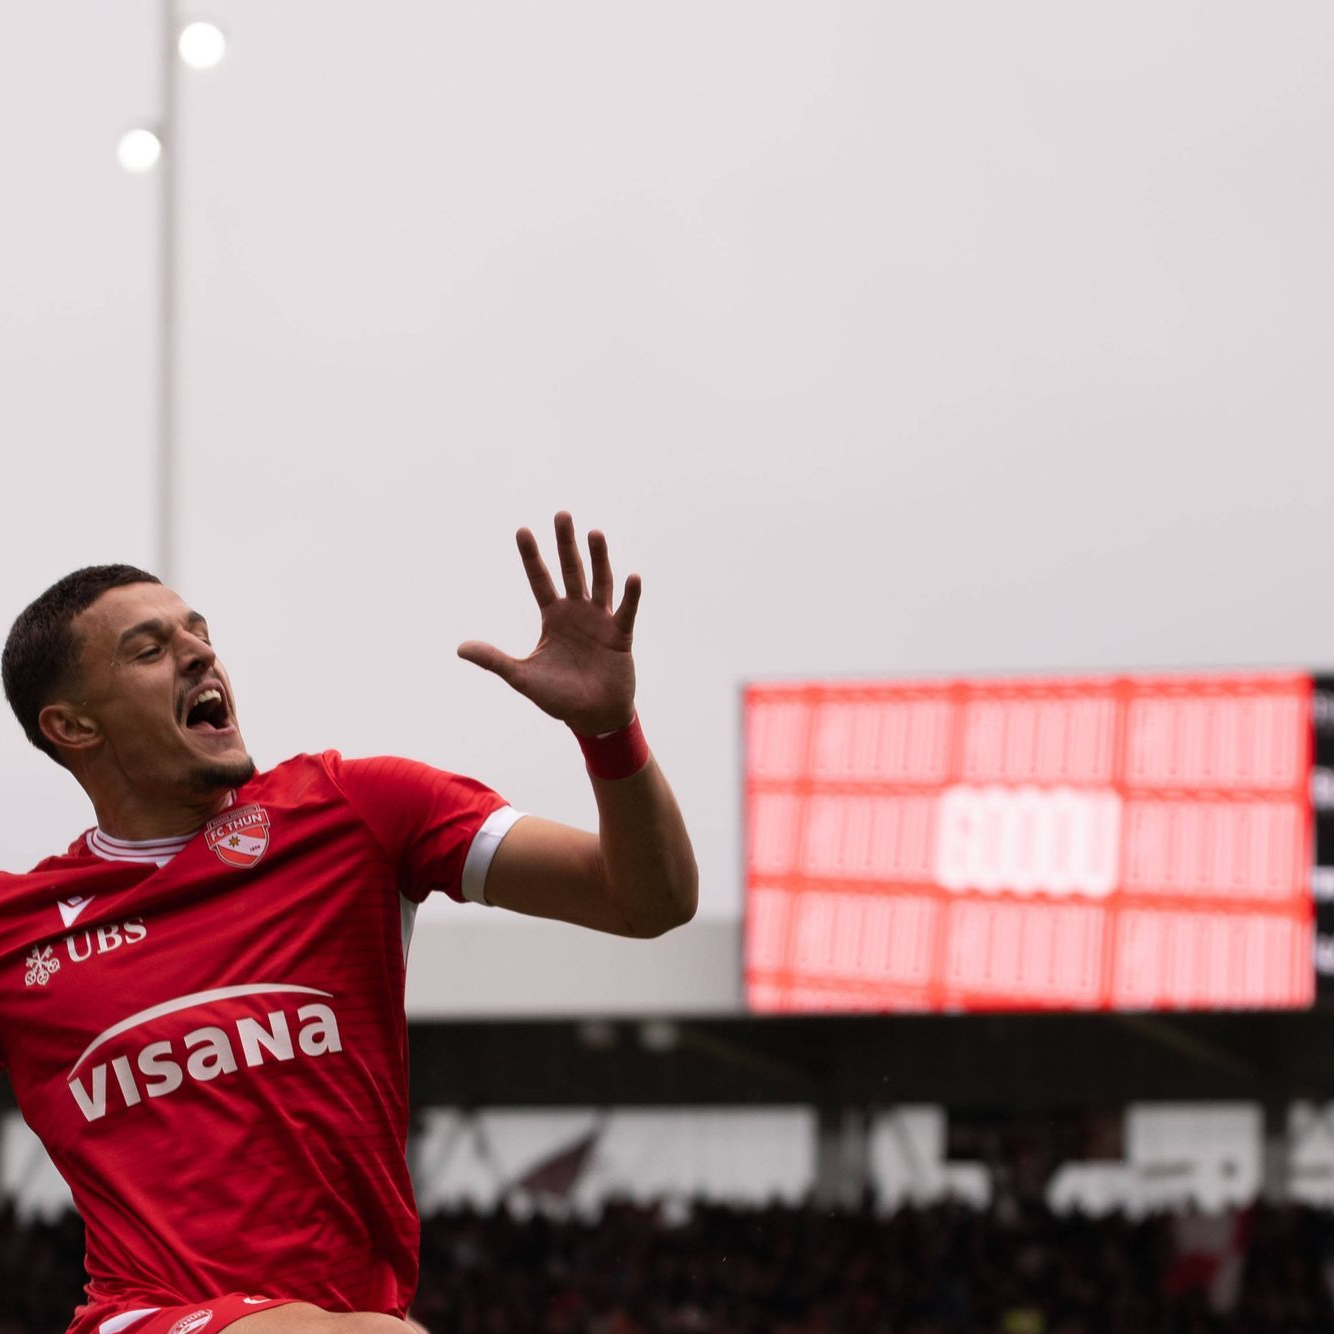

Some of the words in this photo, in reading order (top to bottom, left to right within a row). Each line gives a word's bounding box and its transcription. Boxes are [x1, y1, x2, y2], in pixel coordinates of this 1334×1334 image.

[211, 826, 225, 842] FC
[226, 813, 263, 832] THUN
[64, 918, 147, 963] UBS
